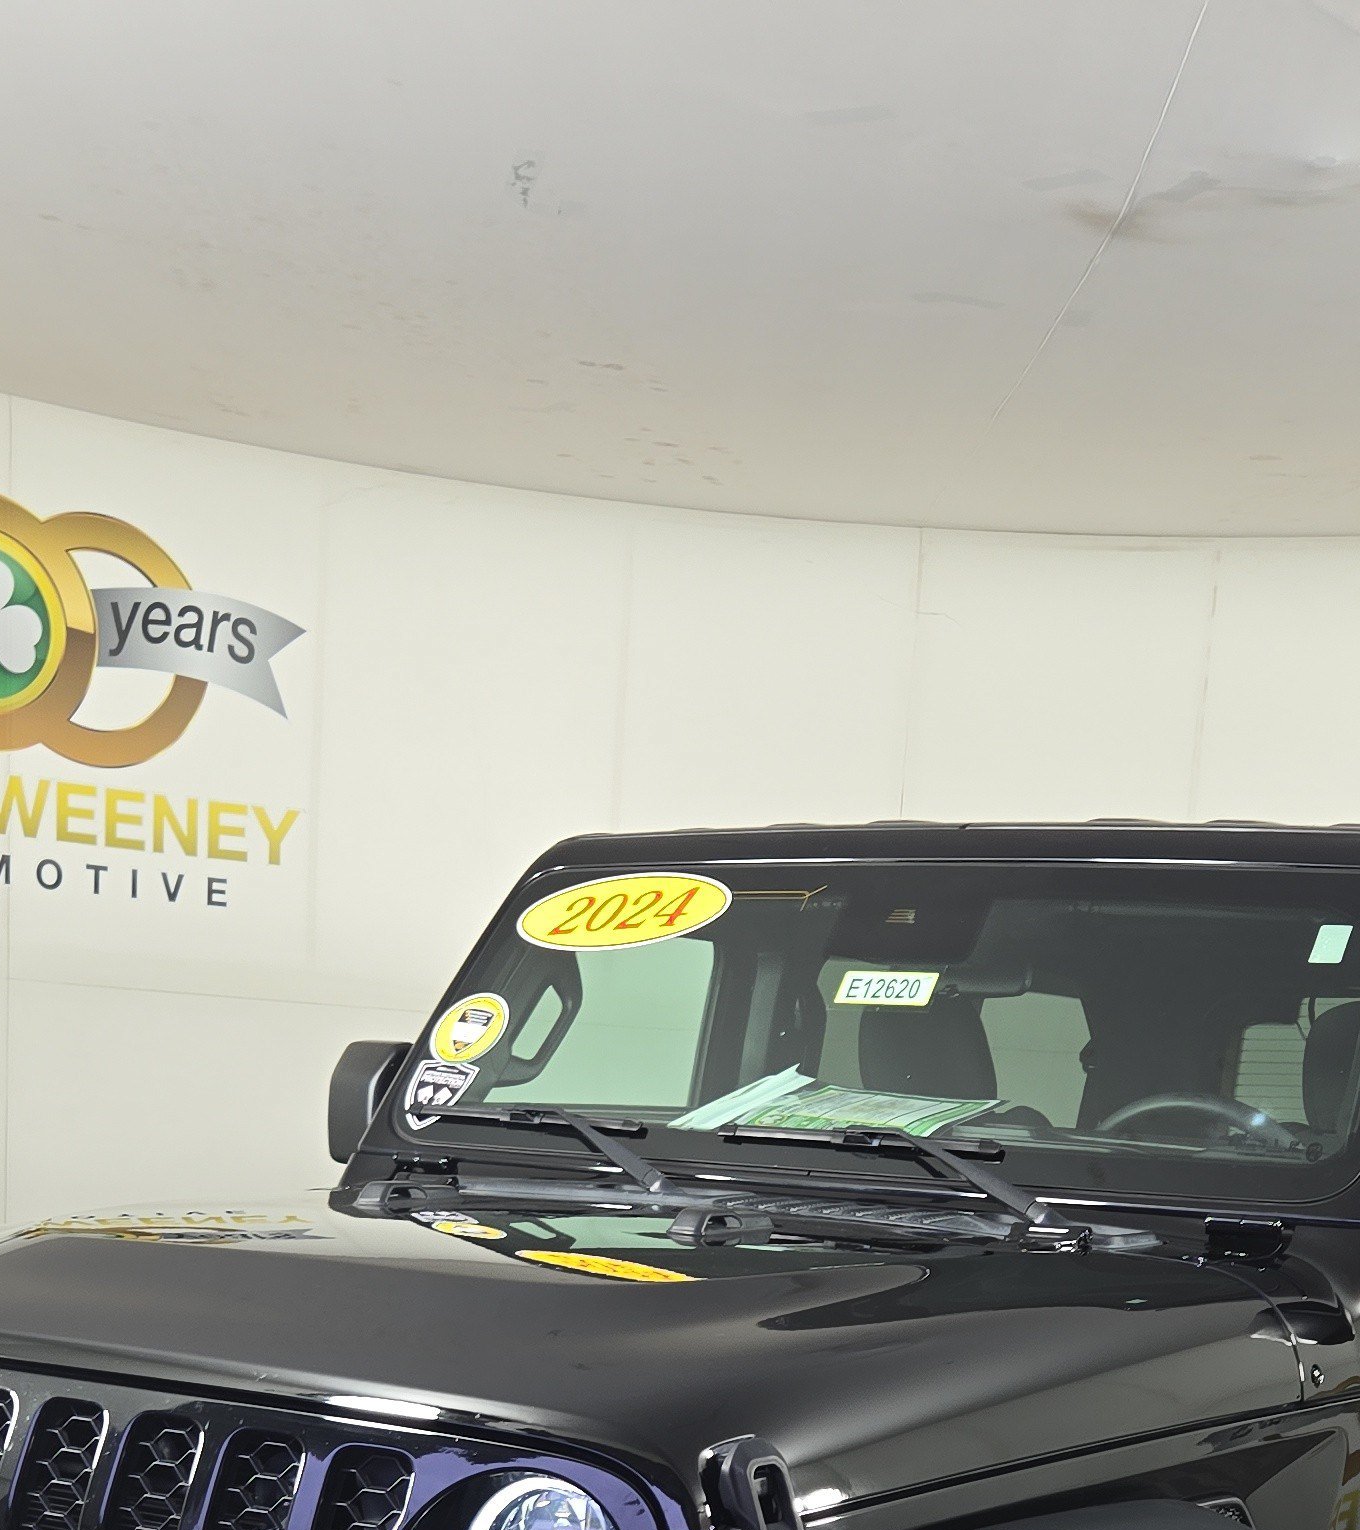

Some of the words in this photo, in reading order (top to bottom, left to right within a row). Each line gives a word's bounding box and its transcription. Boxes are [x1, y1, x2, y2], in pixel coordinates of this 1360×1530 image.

[108, 597, 258, 664] years
[548, 887, 701, 936] 2024
[845, 978, 922, 1000] E12620
